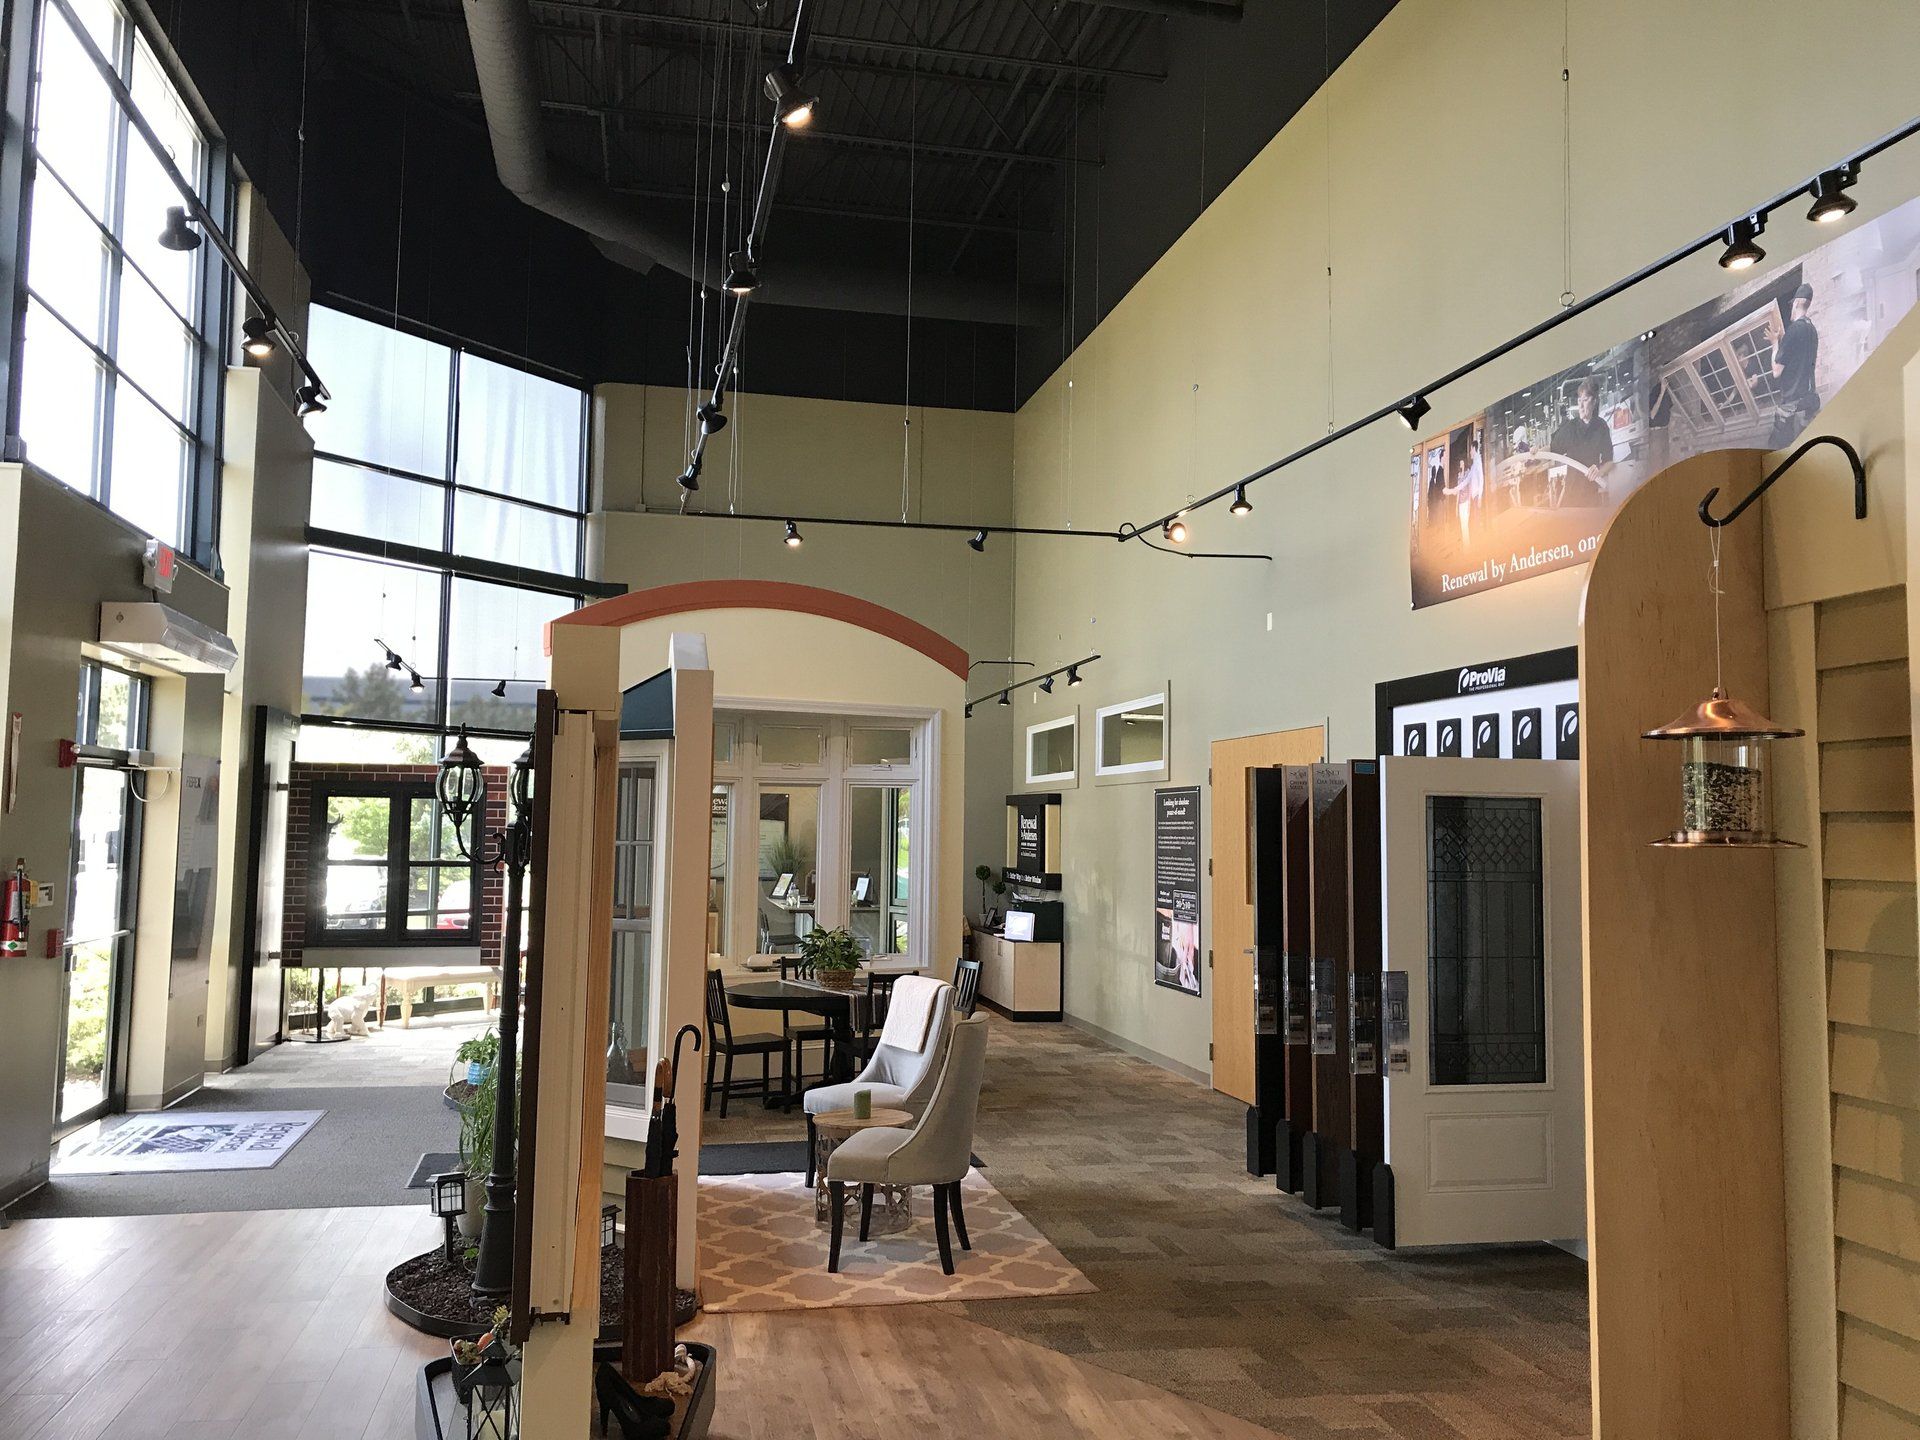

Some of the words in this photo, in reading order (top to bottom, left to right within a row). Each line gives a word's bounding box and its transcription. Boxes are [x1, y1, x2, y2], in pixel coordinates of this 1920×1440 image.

[1441, 560, 1488, 593] Renewal
[1491, 558, 1507, 583] by
[1509, 544, 1574, 574] Andersen,
[1469, 667, 1506, 687] ProVia
[1021, 814, 1037, 829] Renewal
[1024, 829, 1037, 841] Andersen
